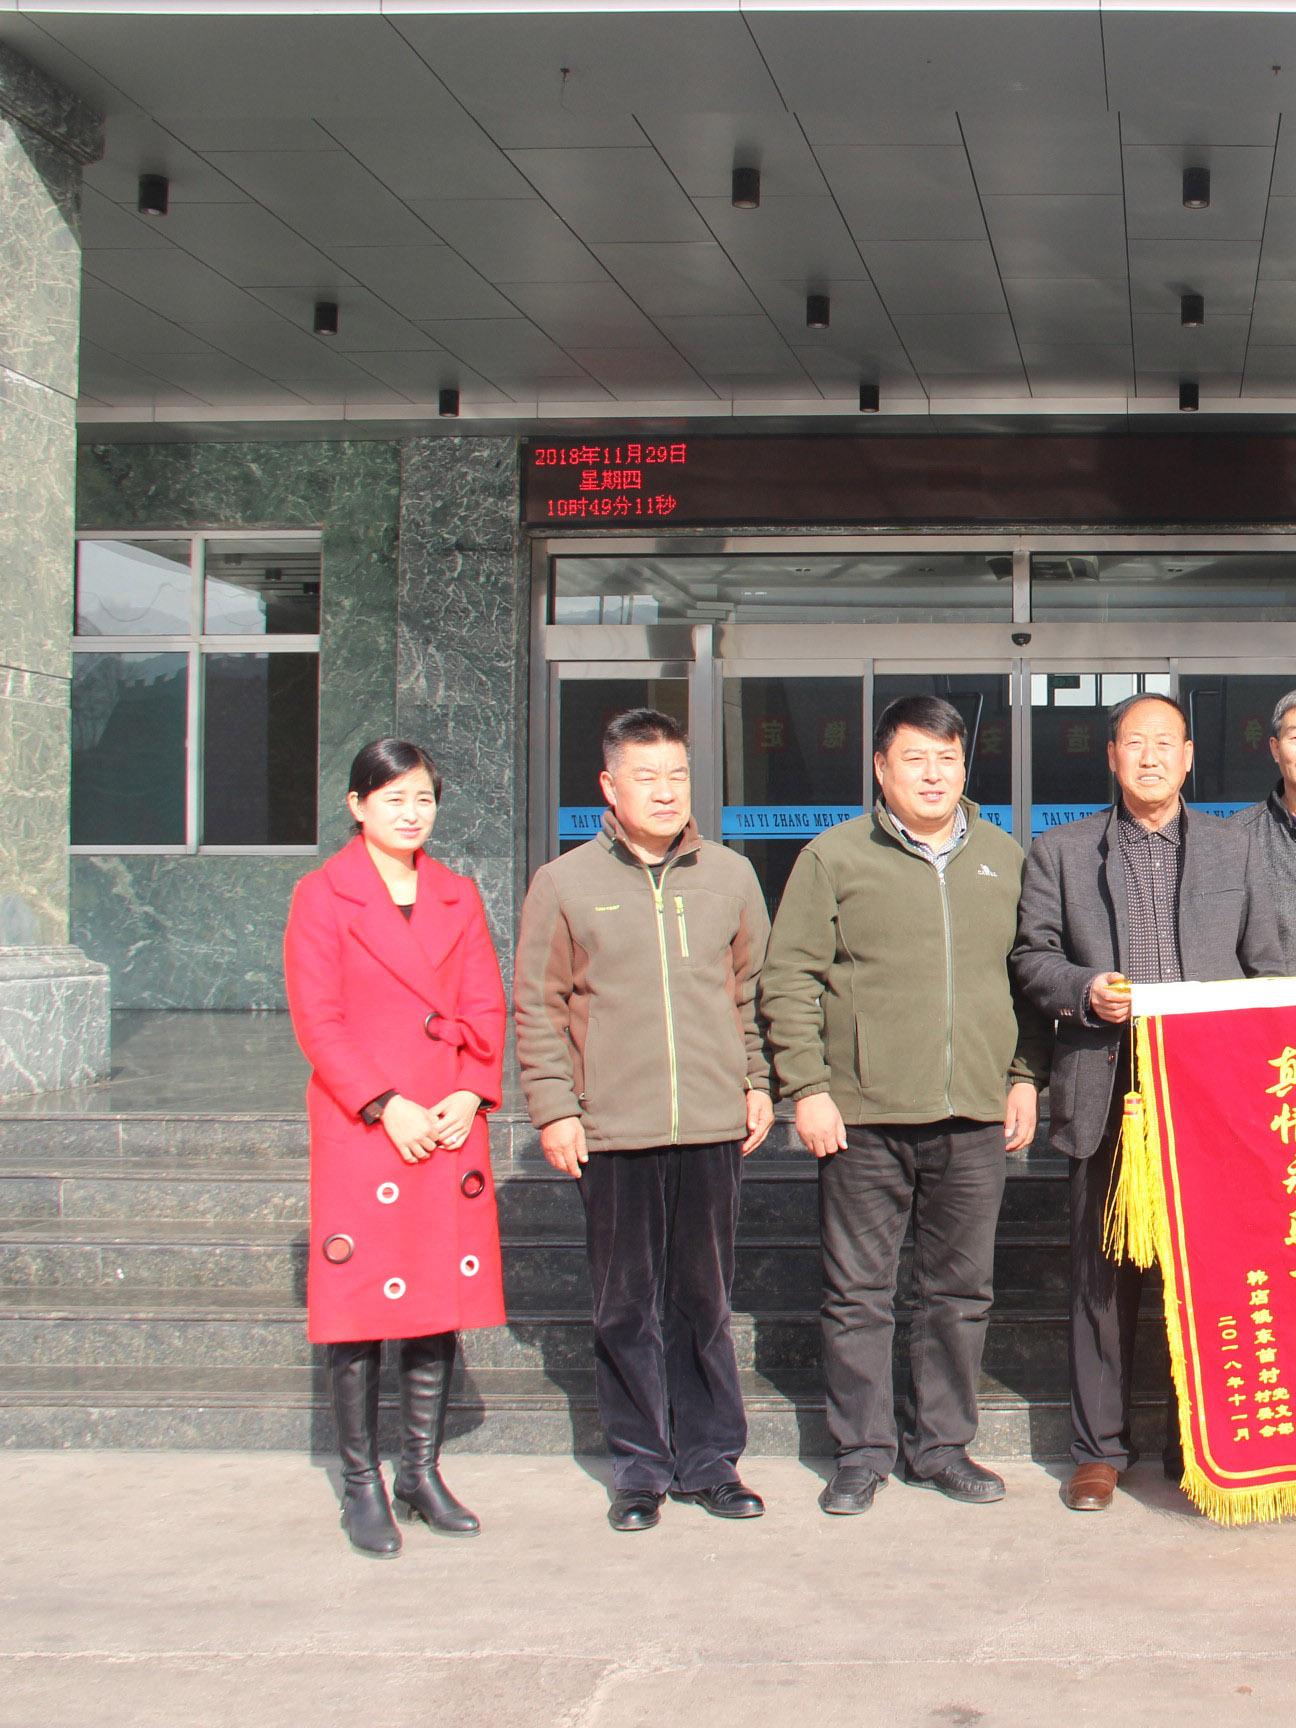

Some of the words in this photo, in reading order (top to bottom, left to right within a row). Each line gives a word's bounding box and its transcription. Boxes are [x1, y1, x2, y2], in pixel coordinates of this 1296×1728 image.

[535, 443, 687, 466] 2018年11月29日
[578, 469, 642, 491] 星期四
[547, 494, 677, 517] 10时49分11秒
[571, 814, 589, 828] TAI
[736, 813, 756, 828] TAI
[757, 813, 770, 828] YI
[773, 813, 810, 828] ZHANG
[814, 813, 835, 827] MEI
[1042, 812, 1062, 826] TAI
